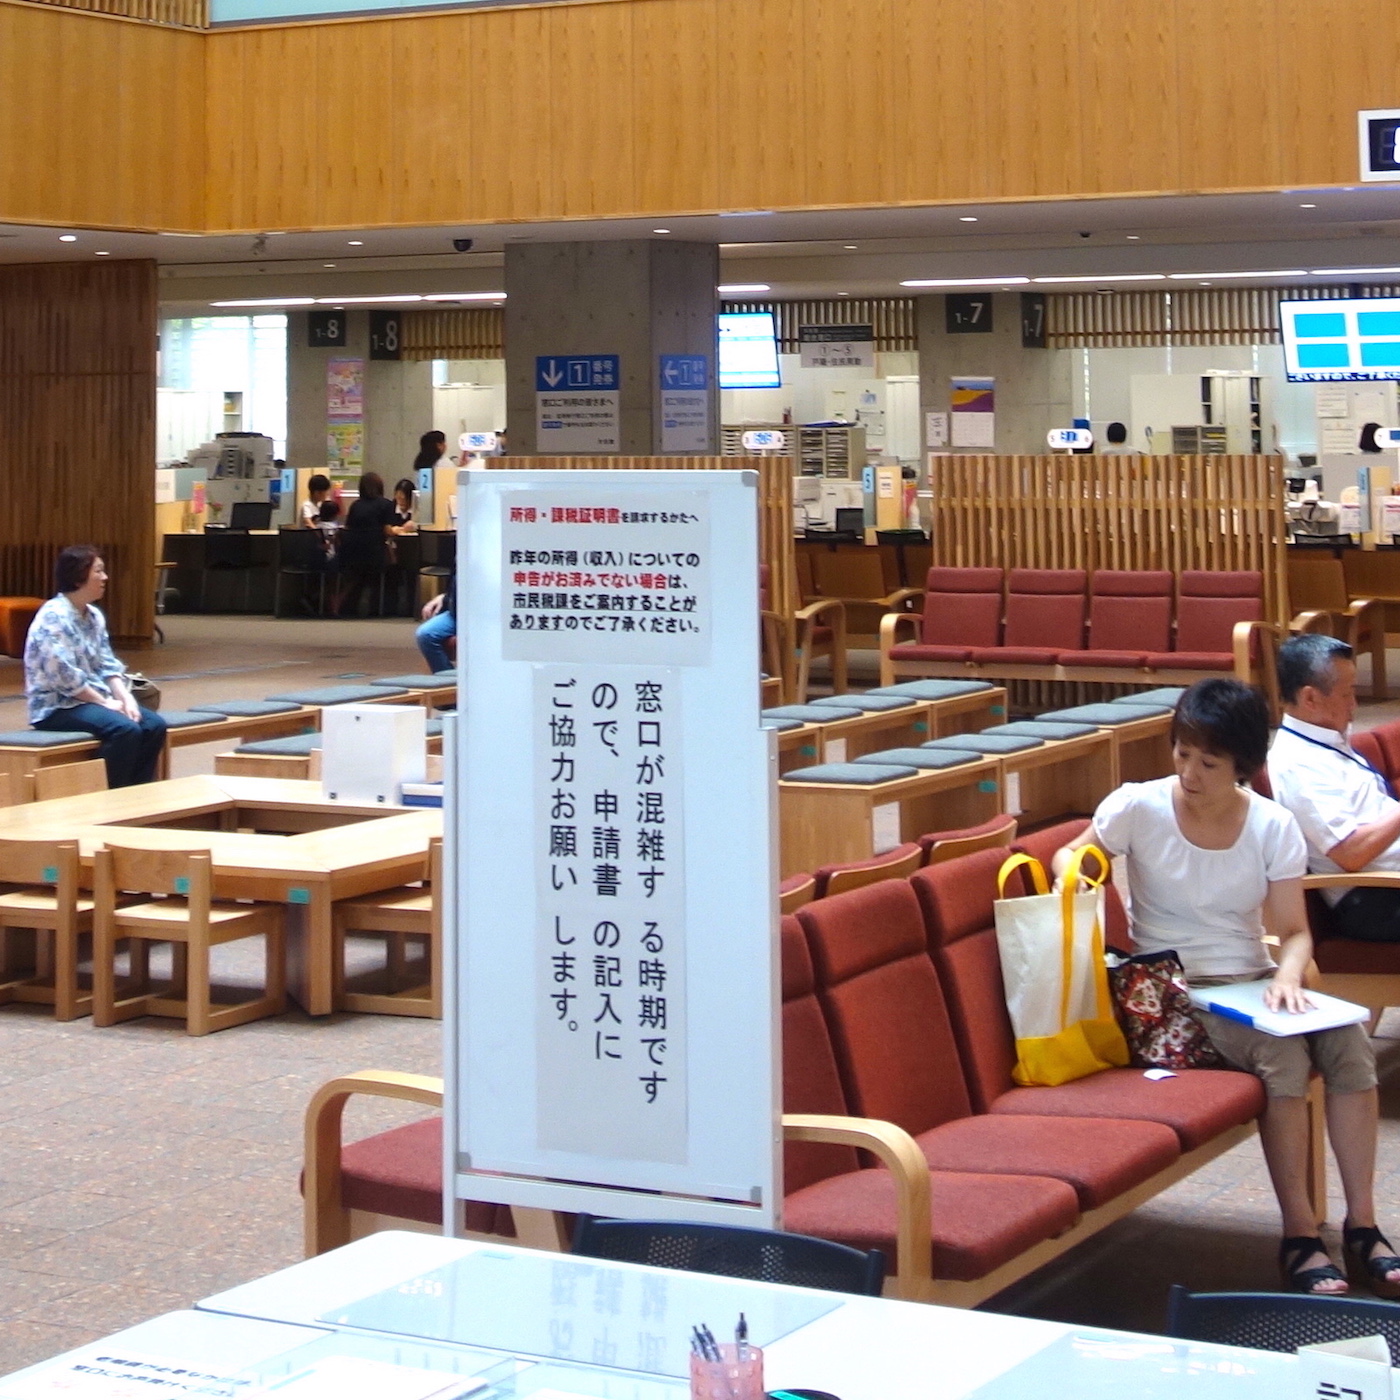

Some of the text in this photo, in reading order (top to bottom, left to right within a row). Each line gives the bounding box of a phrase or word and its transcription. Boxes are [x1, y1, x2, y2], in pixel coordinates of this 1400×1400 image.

[955, 302, 984, 324] 1-7
[1024, 304, 1044, 338] 1-7
[315, 319, 340, 339] 1-8
[372, 320, 398, 351] 1-8
[510, 550, 700, 568] 昨年の所得（収入）についての
[513, 571, 688, 590] 申告がお済みでない場合は、
[513, 592, 697, 611] 市民税課をご案内することが
[509, 614, 700, 633] ありますのでご了承ください。
